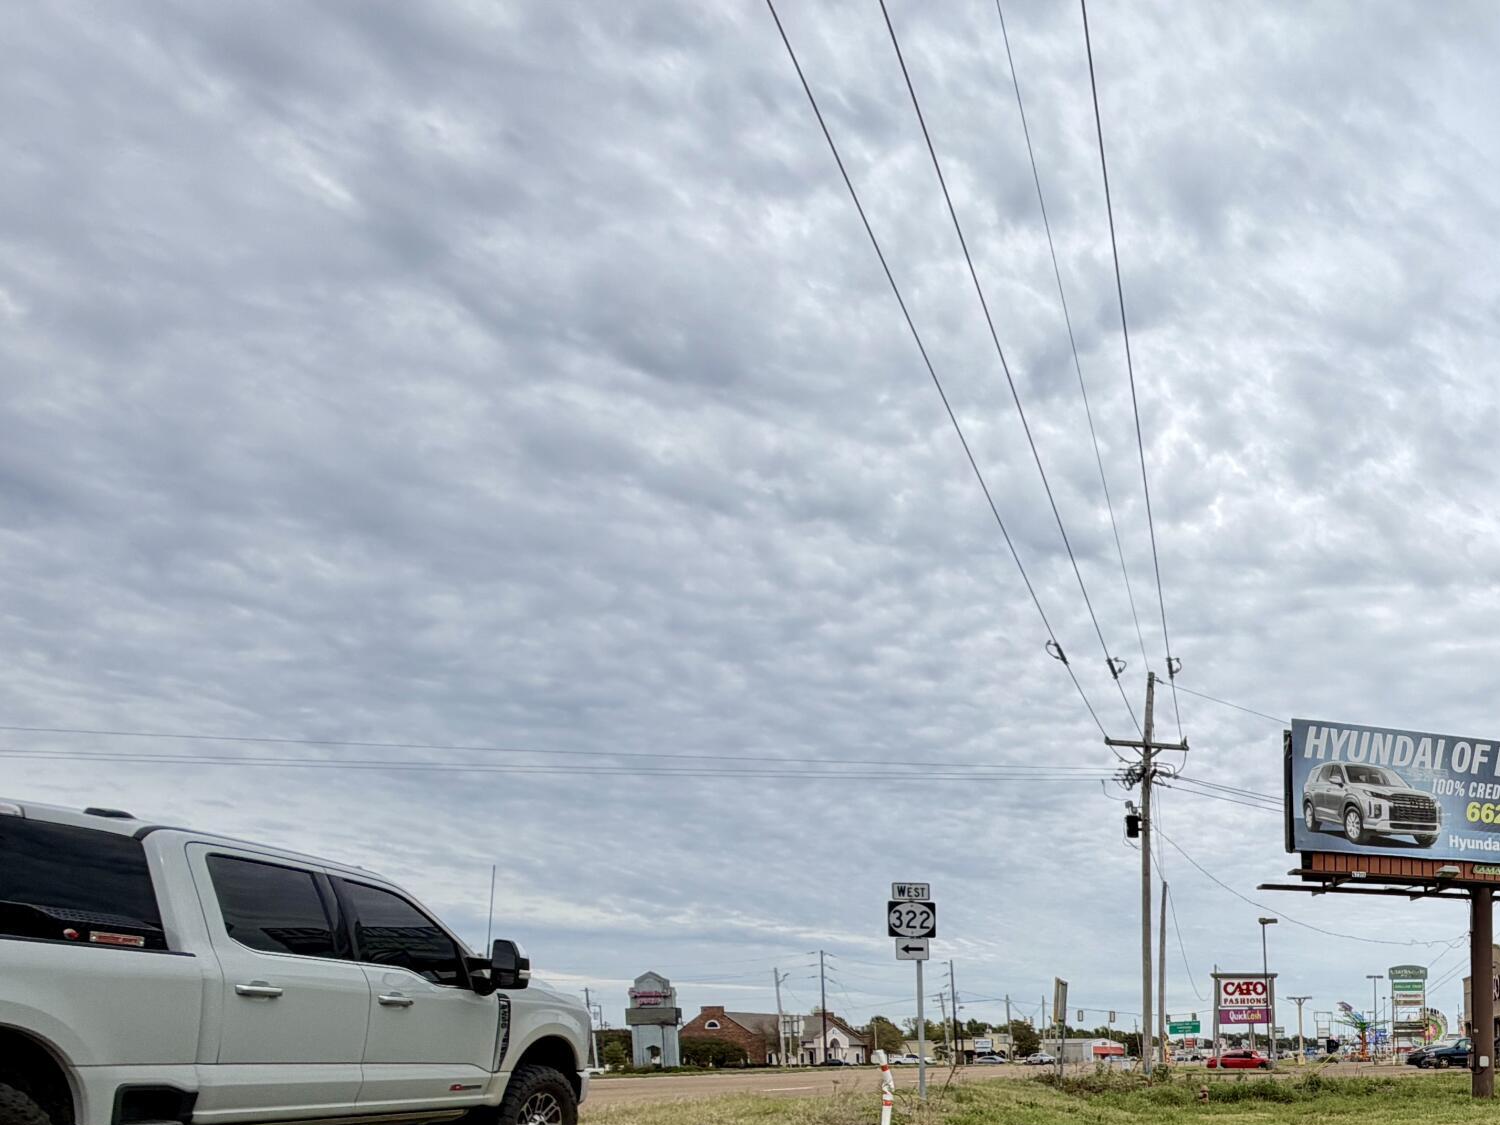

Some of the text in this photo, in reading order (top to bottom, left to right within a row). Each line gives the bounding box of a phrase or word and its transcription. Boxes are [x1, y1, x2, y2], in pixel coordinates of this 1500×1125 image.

[1304, 726, 1445, 769] HYUNDAI
[1451, 741, 1491, 774] OF
[1432, 778, 1465, 797] 100%
[897, 885, 926, 897] WEST
[892, 909, 931, 930] 322
[1223, 981, 1266, 996] CATO
[1229, 1010, 1262, 1022] QuickCash
